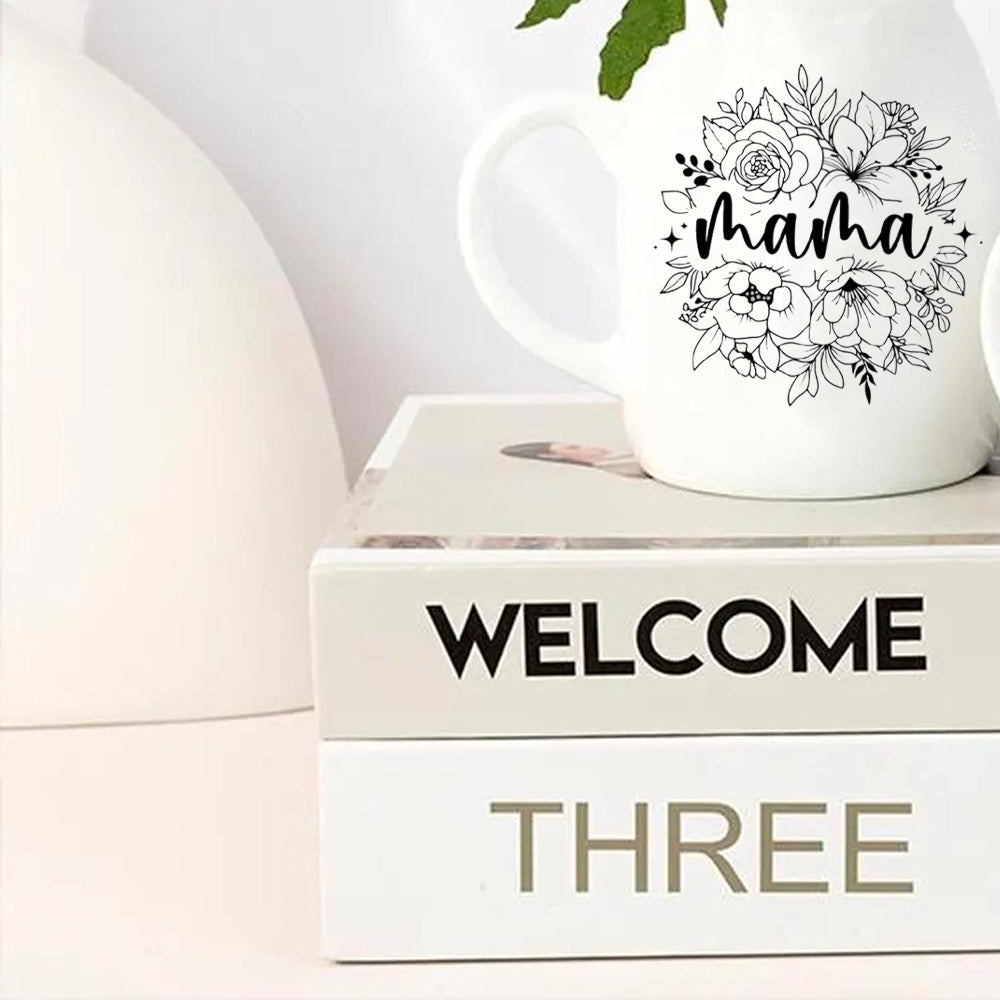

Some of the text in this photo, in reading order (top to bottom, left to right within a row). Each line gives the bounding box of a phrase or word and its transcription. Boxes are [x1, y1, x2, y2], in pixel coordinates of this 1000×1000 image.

[695, 190, 934, 261] mama
[425, 595, 928, 679] WELCOME
[489, 801, 916, 894] THREE
